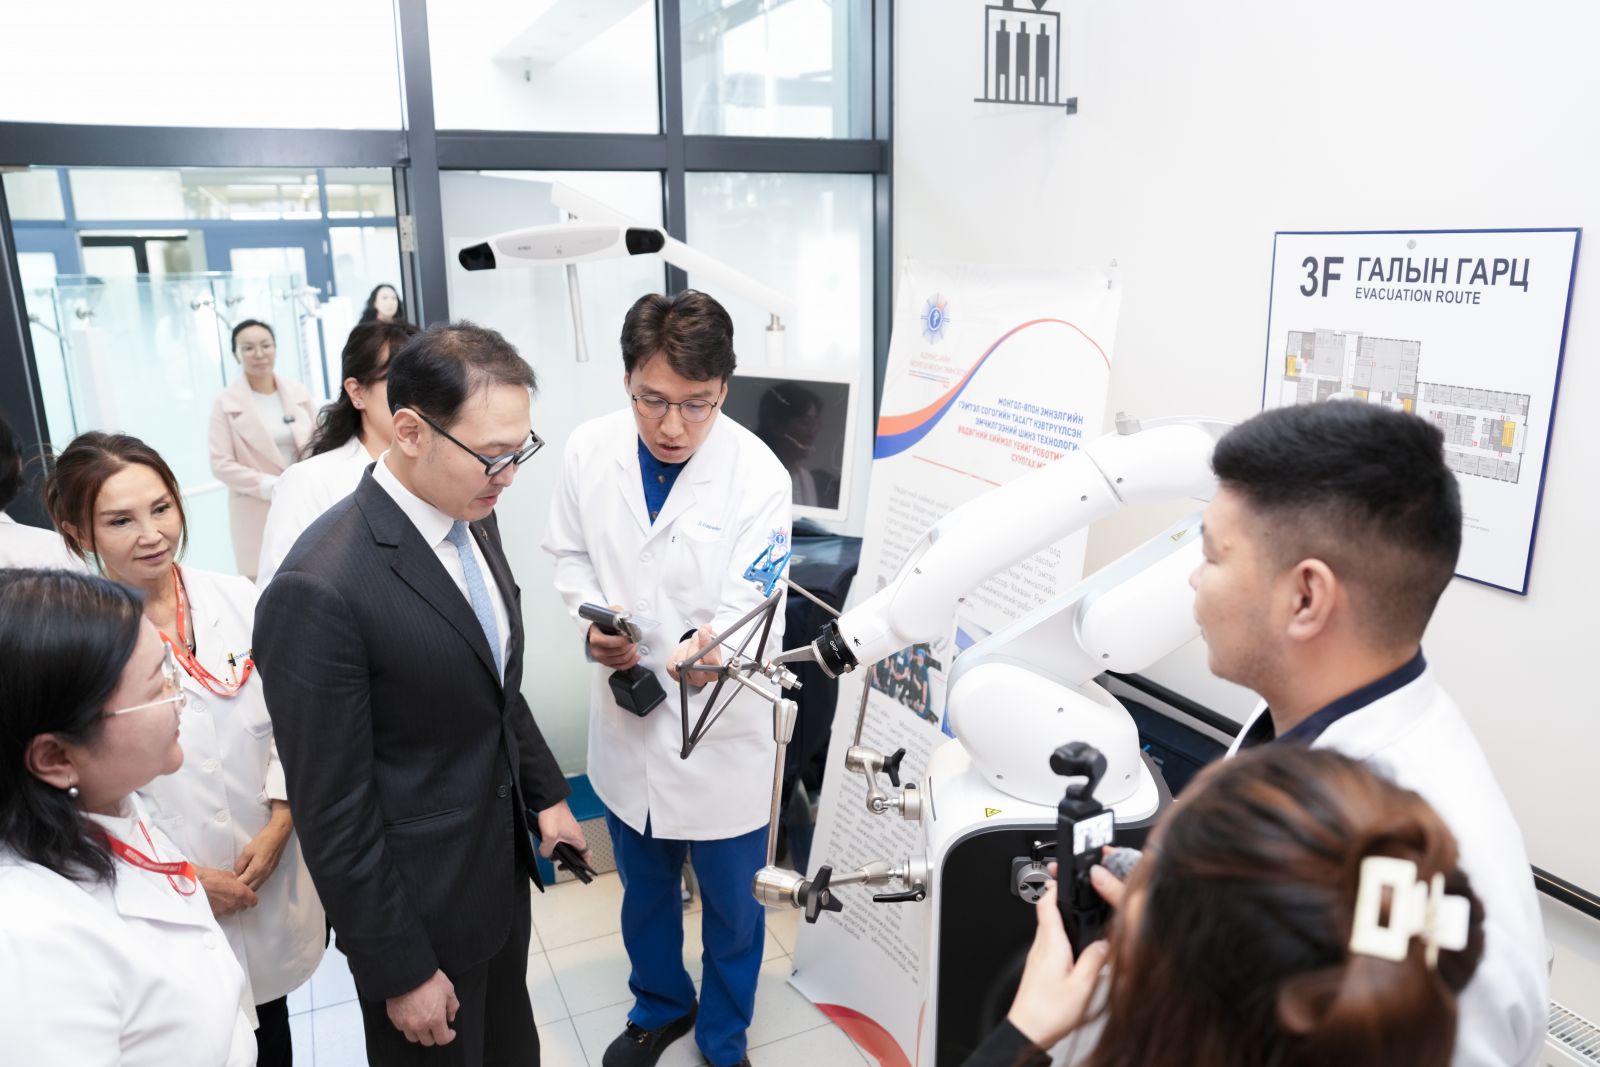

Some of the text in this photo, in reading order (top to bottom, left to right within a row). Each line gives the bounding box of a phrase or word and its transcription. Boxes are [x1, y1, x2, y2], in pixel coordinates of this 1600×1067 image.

[1299, 255, 1345, 298] 3F
[1356, 256, 1531, 293] ГАЛЫН ГАРЦ
[1355, 286, 1482, 305] EVACUATION ROUTE
[998, 397, 1084, 425] МОНГОЛ-ЯПОН ЭМНЭЛГИЙН
[1011, 413, 1033, 427] ТАСАГТ
[1018, 428, 1036, 442] ШИНЭ
